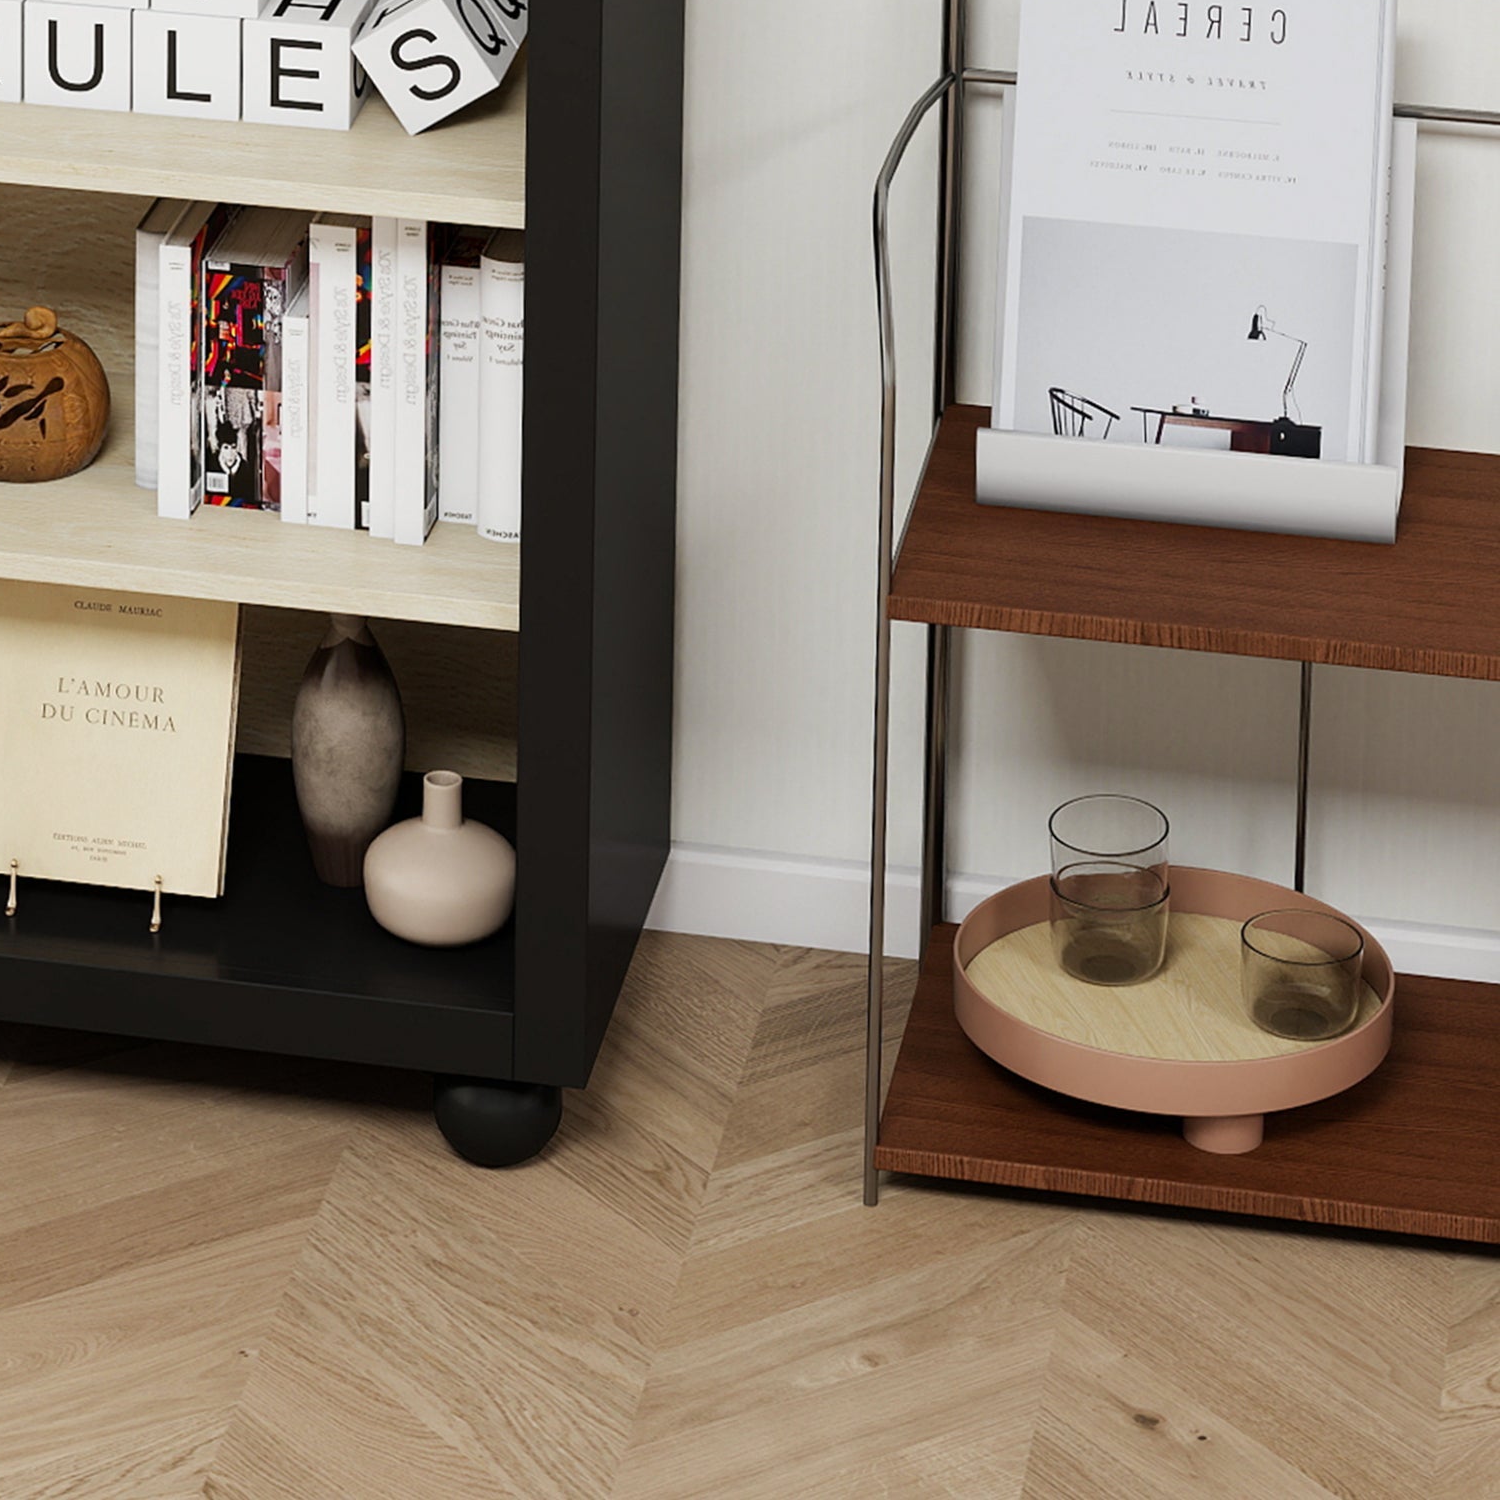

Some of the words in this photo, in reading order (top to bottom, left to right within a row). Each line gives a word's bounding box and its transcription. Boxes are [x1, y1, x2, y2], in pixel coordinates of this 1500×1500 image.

[74, 600, 112, 614] CLAUDE
[118, 605, 163, 618] MAURIAC
[58, 676, 165, 705] L'AMOUR
[41, 703, 76, 723] DU
[85, 707, 177, 733] CINÉMA
